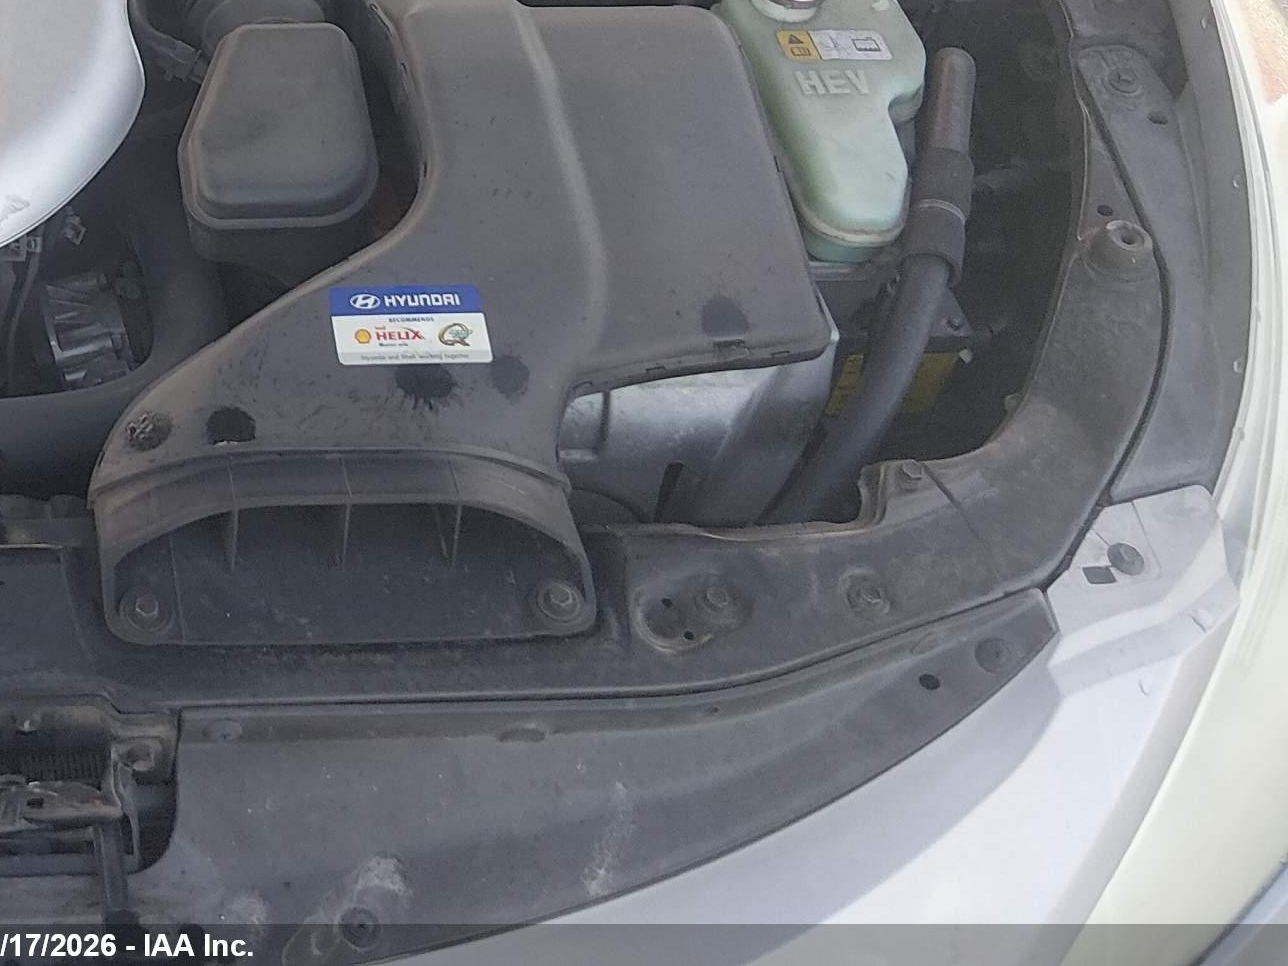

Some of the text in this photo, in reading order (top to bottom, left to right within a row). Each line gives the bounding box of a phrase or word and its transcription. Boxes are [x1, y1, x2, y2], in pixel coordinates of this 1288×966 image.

[793, 69, 870, 96] HEV
[384, 293, 461, 307] HYUNDAI
[375, 330, 425, 341] HELIX
